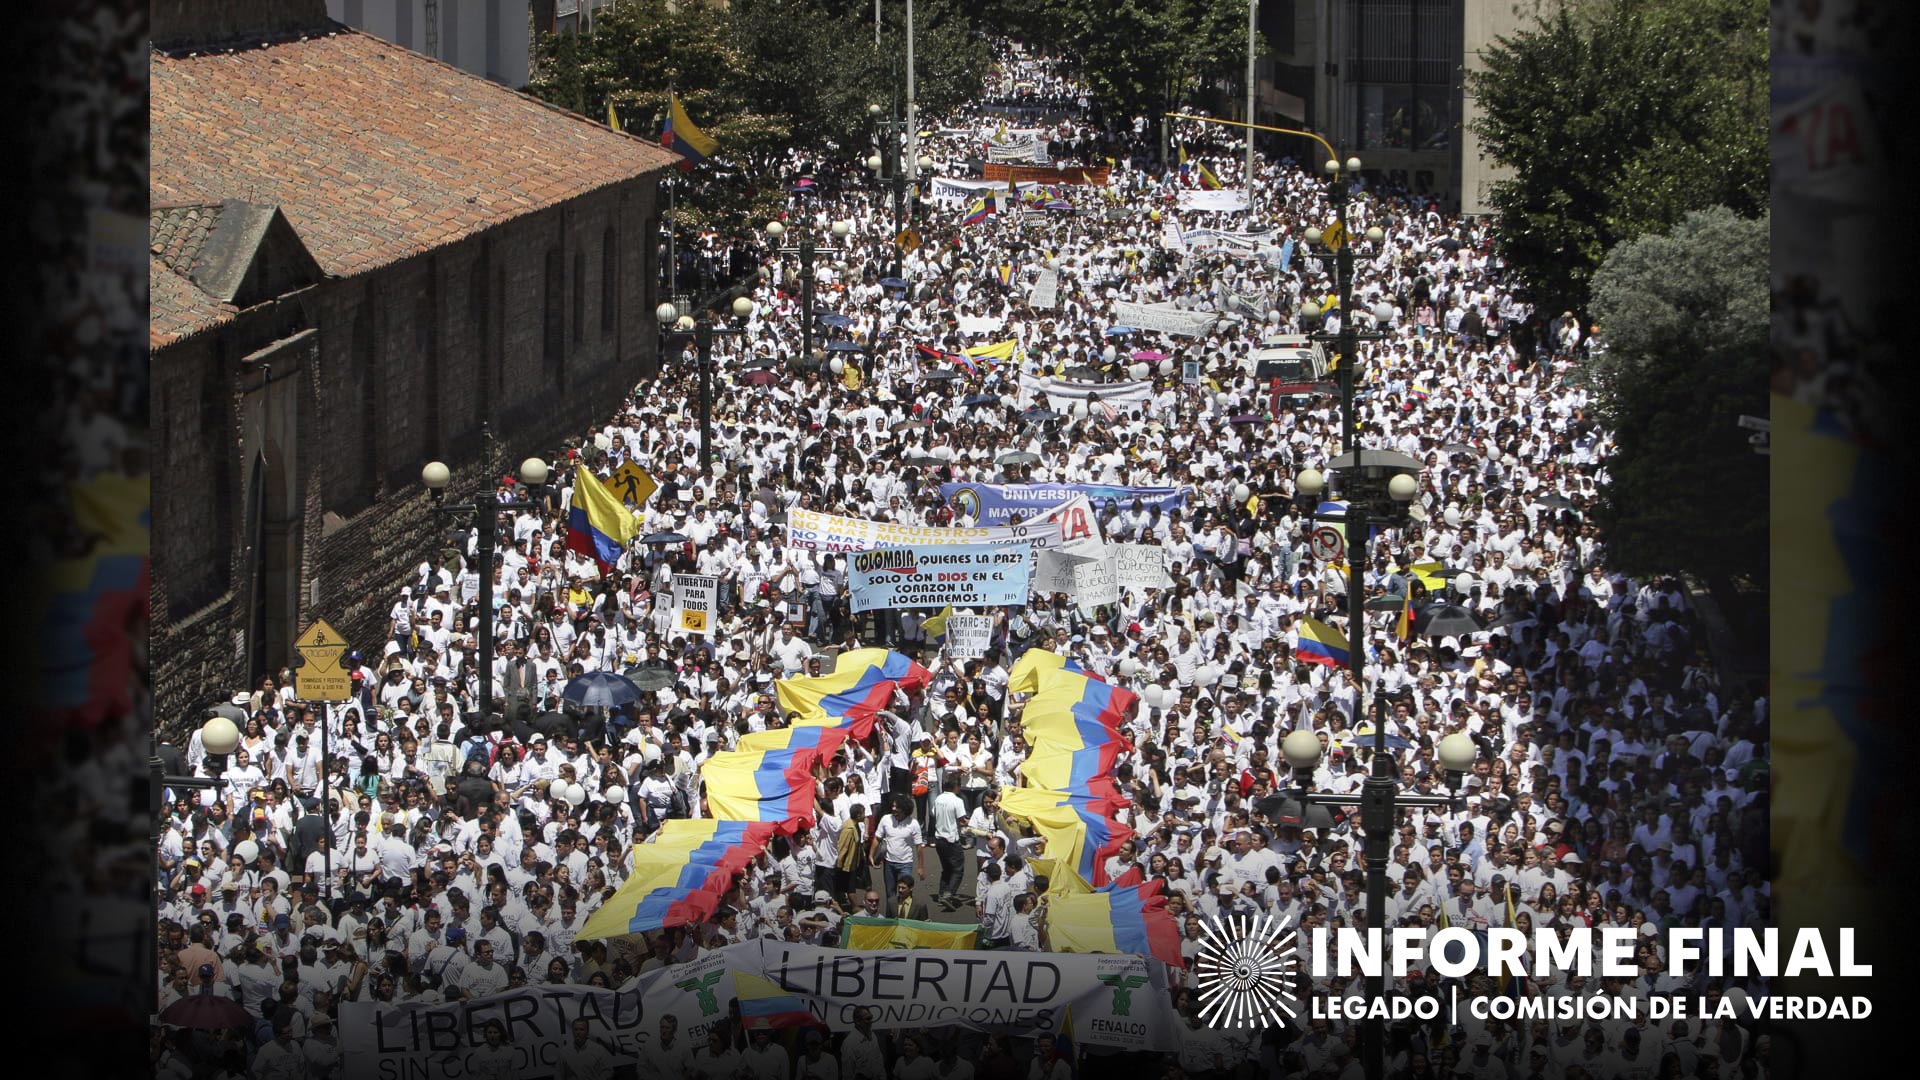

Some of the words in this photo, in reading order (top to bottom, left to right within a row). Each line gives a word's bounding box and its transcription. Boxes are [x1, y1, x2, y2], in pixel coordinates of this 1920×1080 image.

[792, 509, 819, 521] NO
[829, 516, 868, 530] MAS
[877, 524, 989, 537] SECUESTROS
[792, 520, 818, 531] NO
[828, 526, 867, 538] MAS
[875, 533, 969, 545] MENTIRAS
[792, 530, 817, 540] NO
[826, 534, 865, 545] MAS
[1011, 527, 1028, 537] YO
[792, 539, 817, 549] NO
[826, 543, 865, 552] MAS
[919, 553, 971, 565] QUIERES
[976, 554, 989, 563] LA
[993, 553, 1023, 563] PAZ?
[677, 577, 714, 588] LIBERTAD
[869, 573, 901, 585] SOLO
[906, 573, 933, 582] CON
[937, 572, 968, 582] DIOS
[972, 572, 987, 580] EN
[992, 572, 1004, 581] EL
[685, 588, 706, 599] PARA
[895, 583, 956, 593] CORAZON
[961, 583, 974, 592] LA
[682, 599, 708, 610] TODOS
[684, 959, 726, 976] Comerciantes
[780, 951, 1061, 1003] LIBERTAD
[376, 990, 644, 1053] LIBERTAD
[1091, 1018, 1147, 1036] FENALCO
